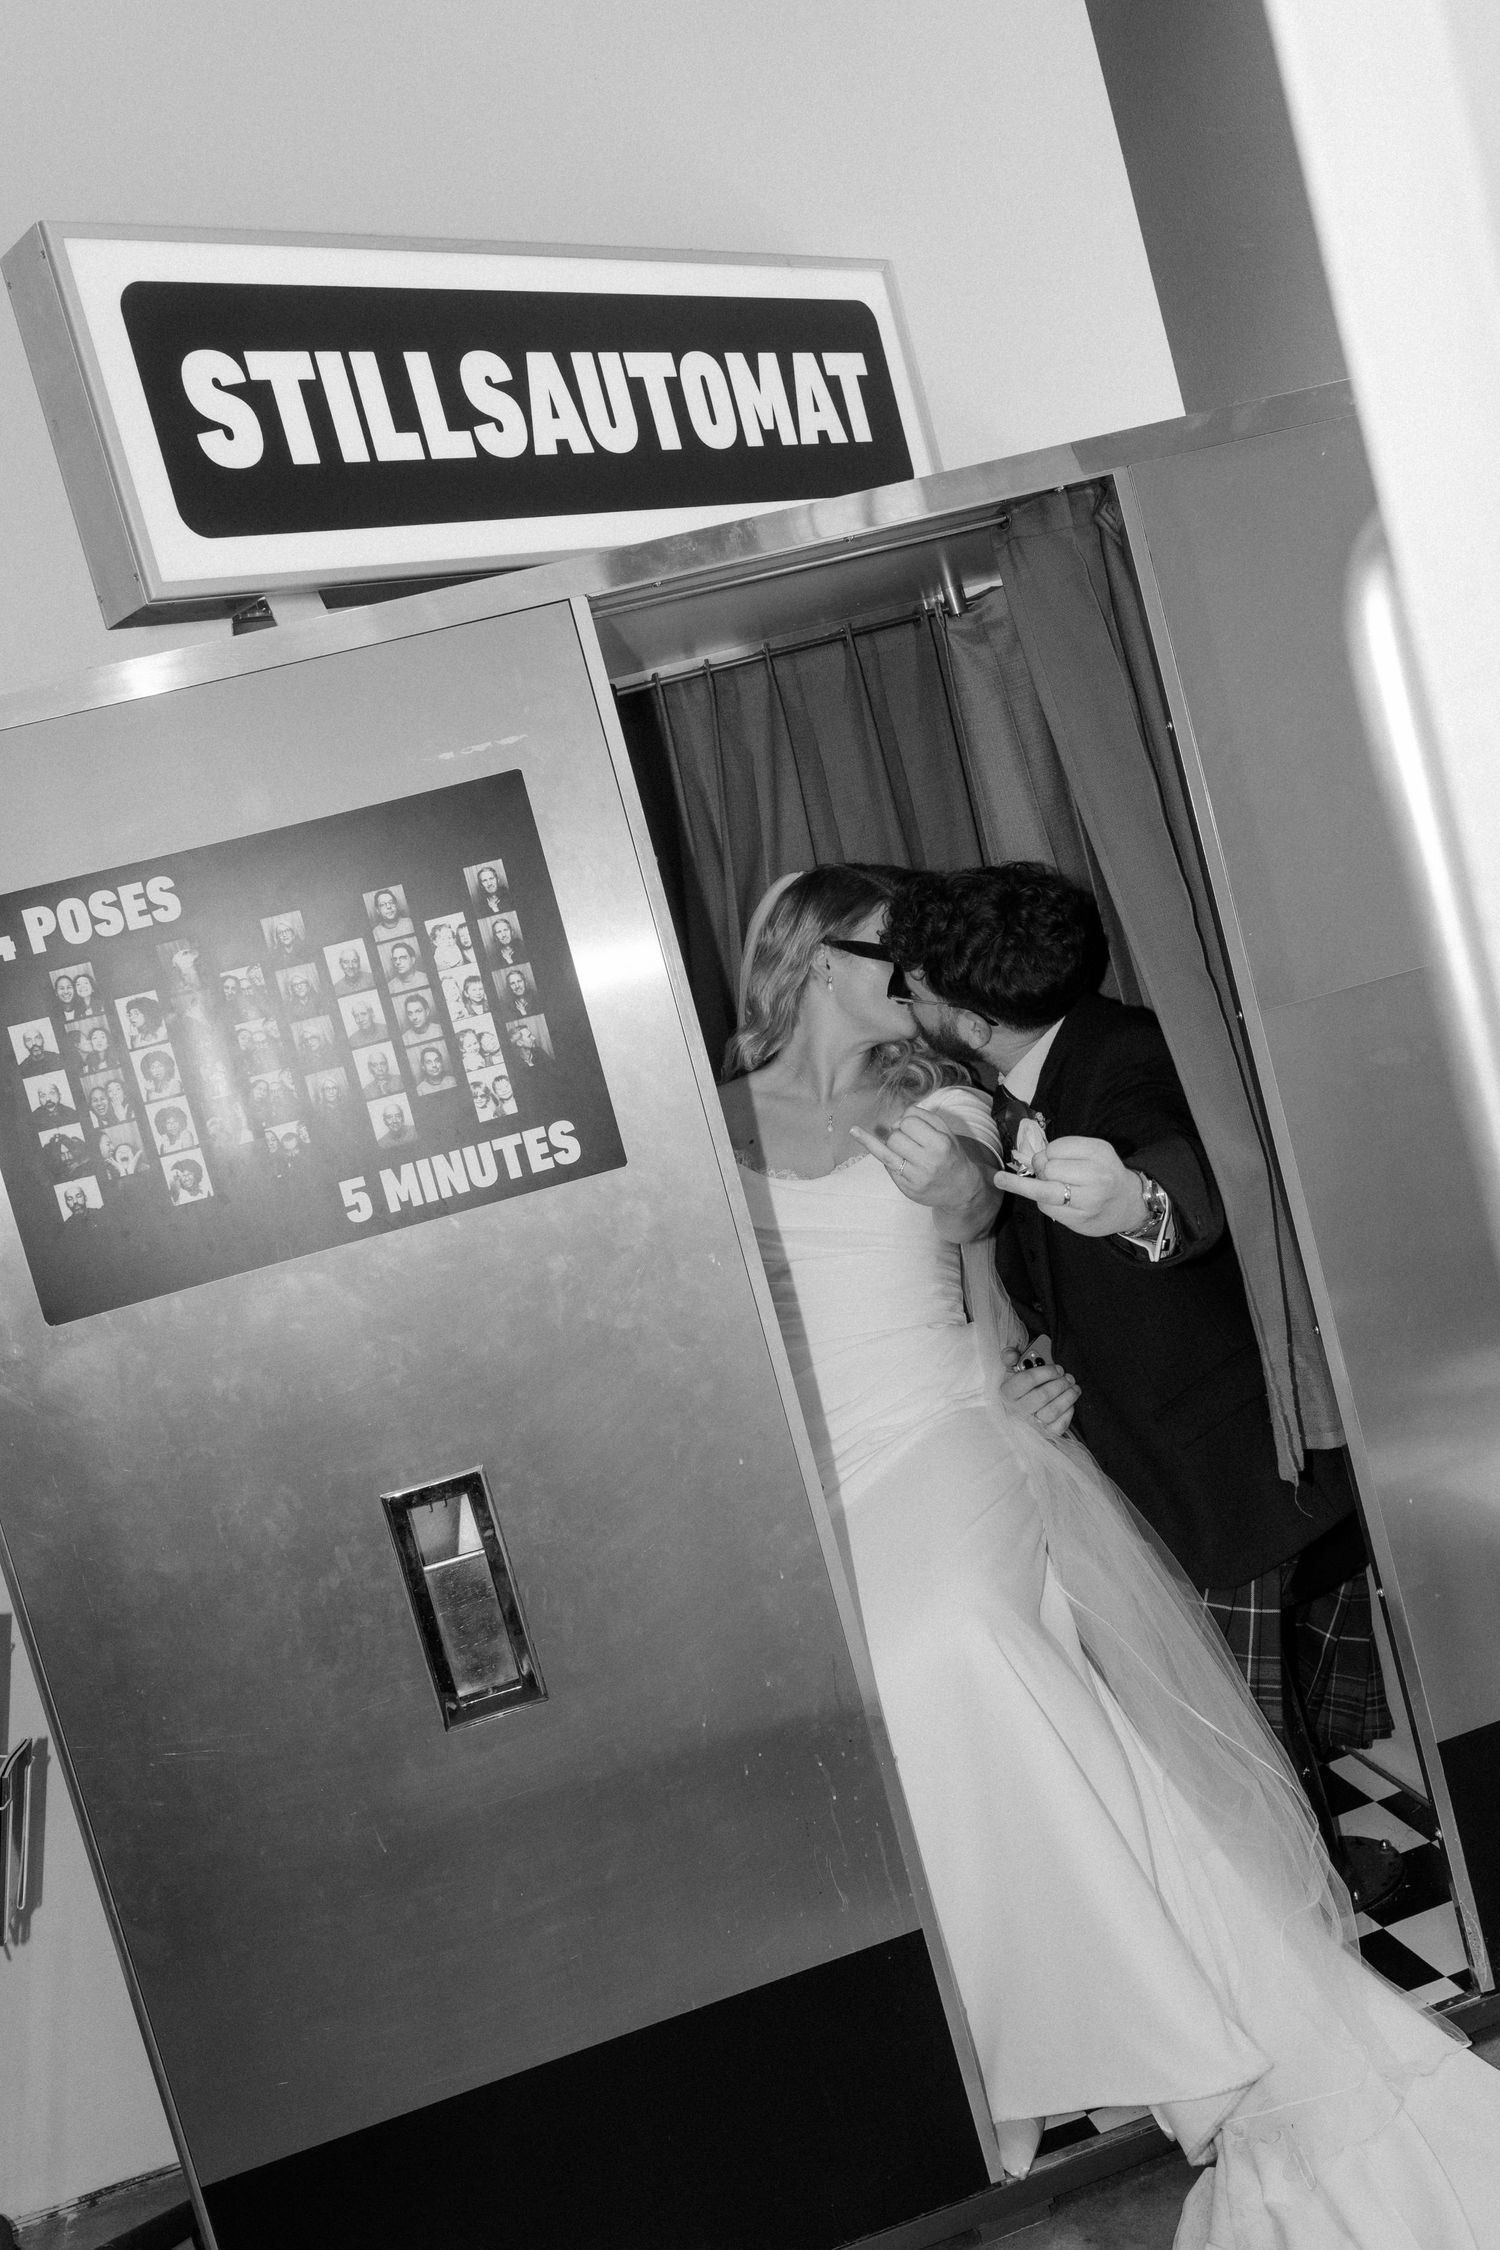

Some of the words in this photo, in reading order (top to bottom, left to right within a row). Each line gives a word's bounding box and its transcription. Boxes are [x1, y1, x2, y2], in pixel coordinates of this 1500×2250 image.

[181, 349, 873, 469] STILLSAUTOMAT
[21, 875, 182, 955] POSES
[338, 1175, 374, 1223] 5
[379, 1119, 582, 1214] MINUTES
